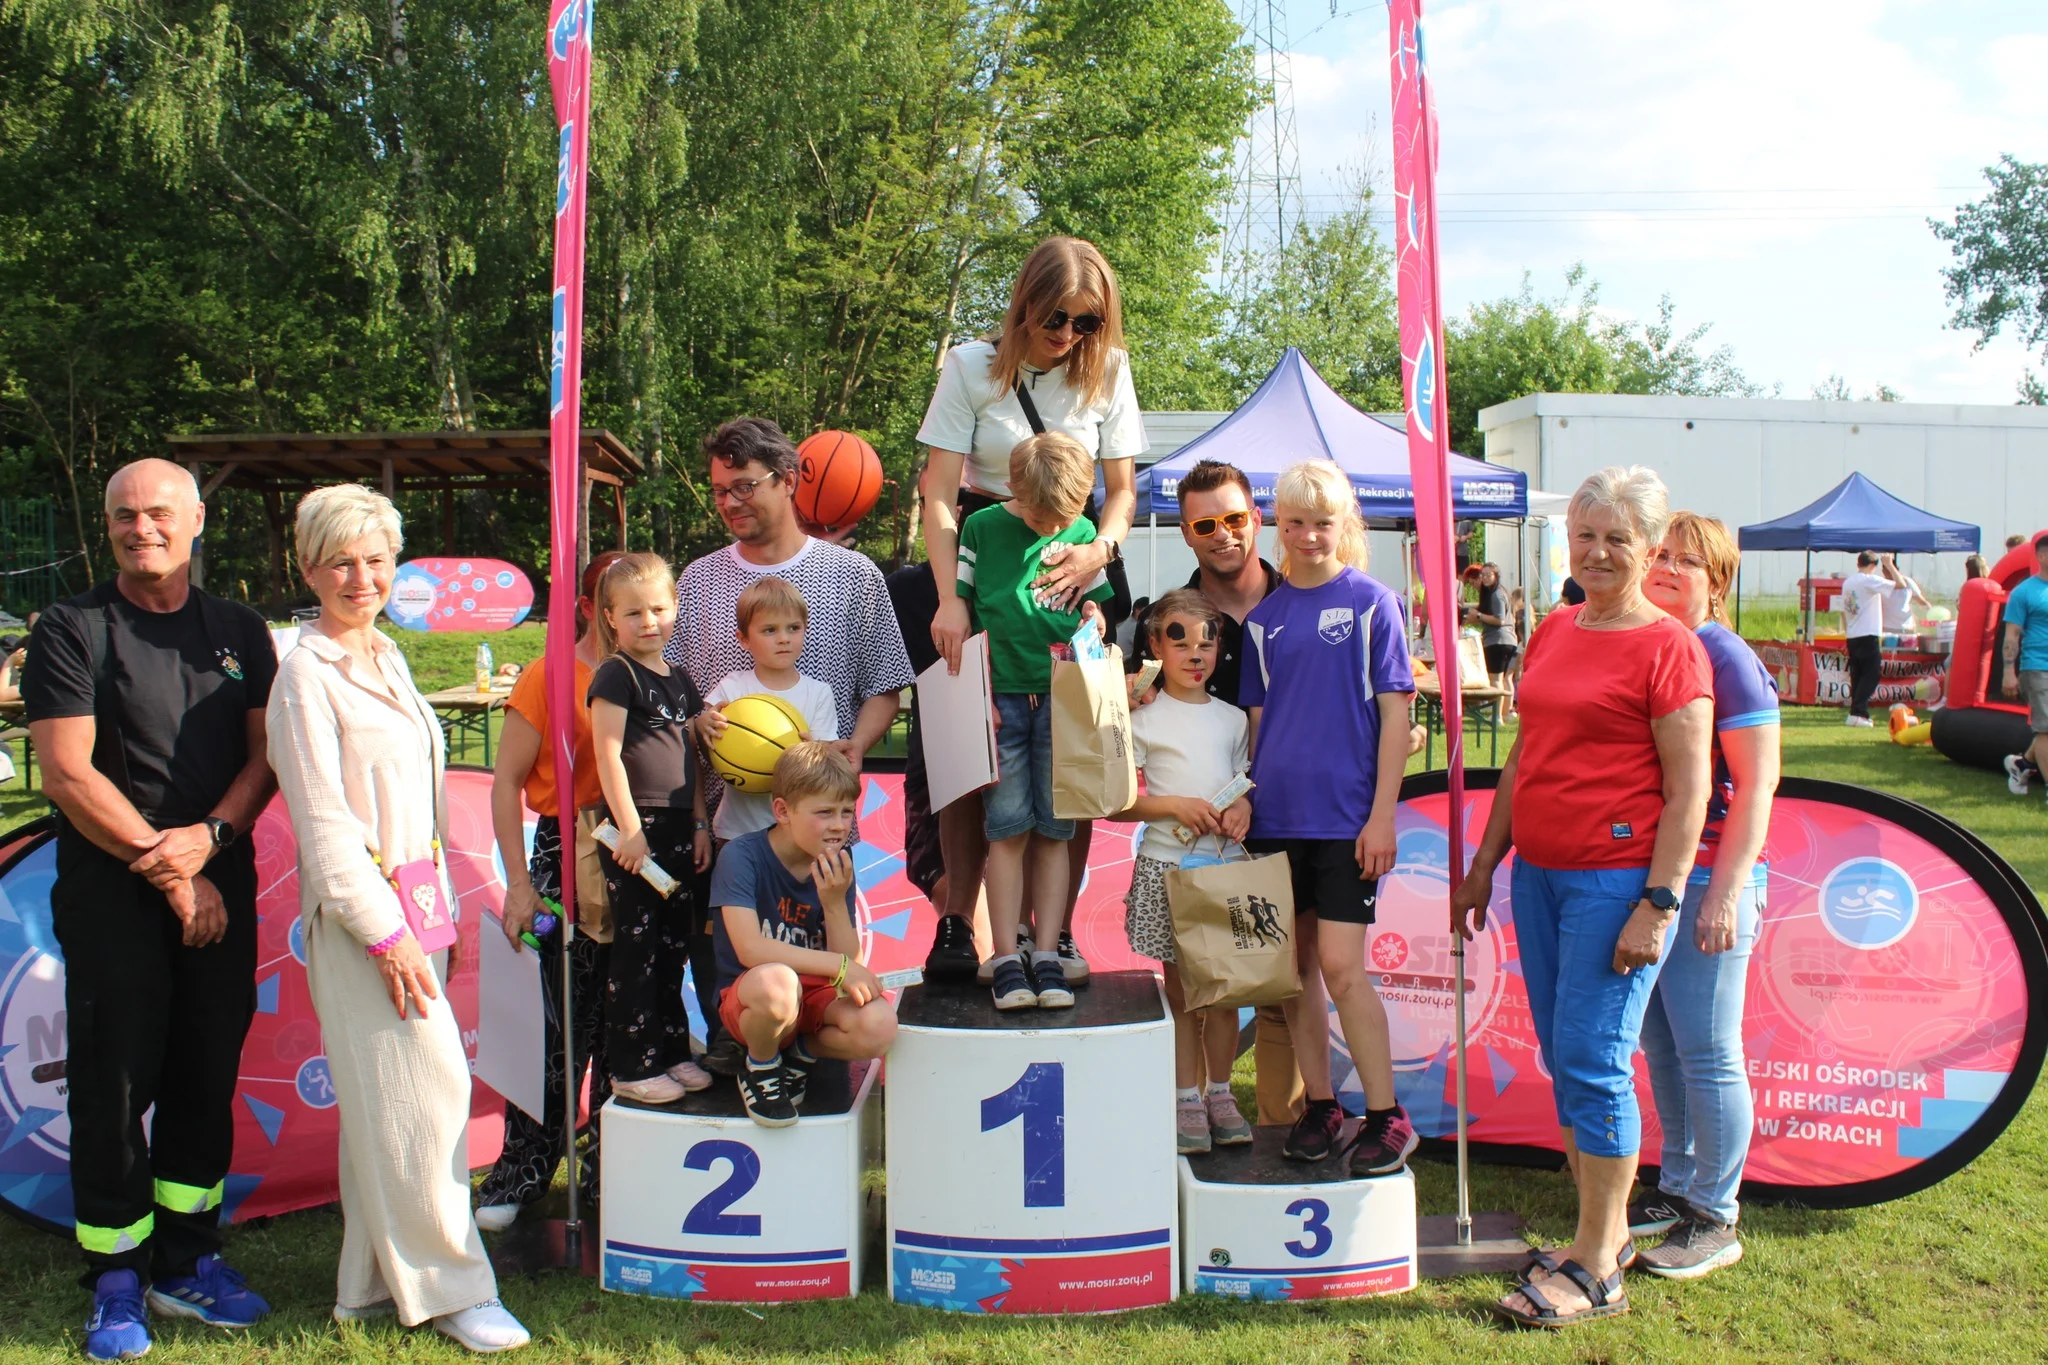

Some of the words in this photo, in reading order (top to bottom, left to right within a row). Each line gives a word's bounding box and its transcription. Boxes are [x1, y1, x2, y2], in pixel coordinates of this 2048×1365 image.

[1359, 487, 1405, 499] Rekreacji
[1813, 653, 1850, 671] WAT
[1881, 660, 1946, 677] UKROW
[1748, 1059, 1809, 1082] EJSKI
[1816, 1061, 1928, 1091] OŚRODEK
[1765, 1090, 1771, 1108] I
[1778, 1091, 1906, 1119] REKREACJI
[981, 1062, 1065, 1208] 1
[1758, 1117, 1780, 1137] W
[1786, 1116, 1882, 1147] ŻORACH
[682, 1139, 761, 1237] 2
[1284, 1198, 1333, 1258] 3
[755, 1276, 831, 1288] www.mosir.zory.pl
[1058, 1271, 1153, 1290] www.mosir.zory.pl
[1322, 1274, 1393, 1291] www.mosir.zory.pl
